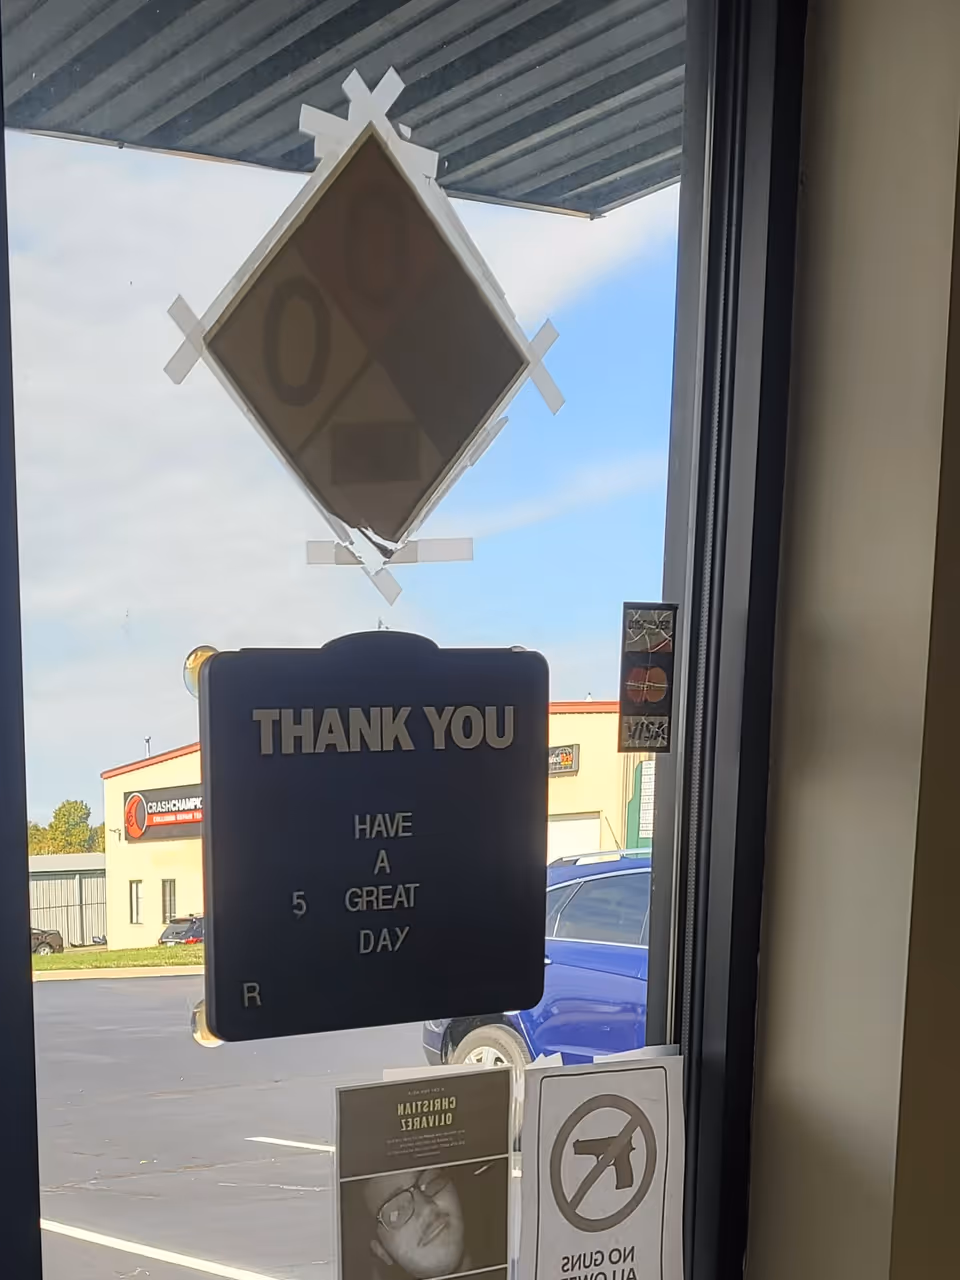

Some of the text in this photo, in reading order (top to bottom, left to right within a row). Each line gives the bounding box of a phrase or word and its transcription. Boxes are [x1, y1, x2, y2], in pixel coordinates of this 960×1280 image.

[263, 274, 331, 406] 0
[253, 705, 514, 755] THANK YOU
[626, 719, 666, 741] VISA
[354, 812, 413, 840] HAVE
[373, 849, 391, 875] A
[345, 883, 420, 912] GREAT
[359, 926, 410, 954] DAY
[243, 982, 262, 1007] R
